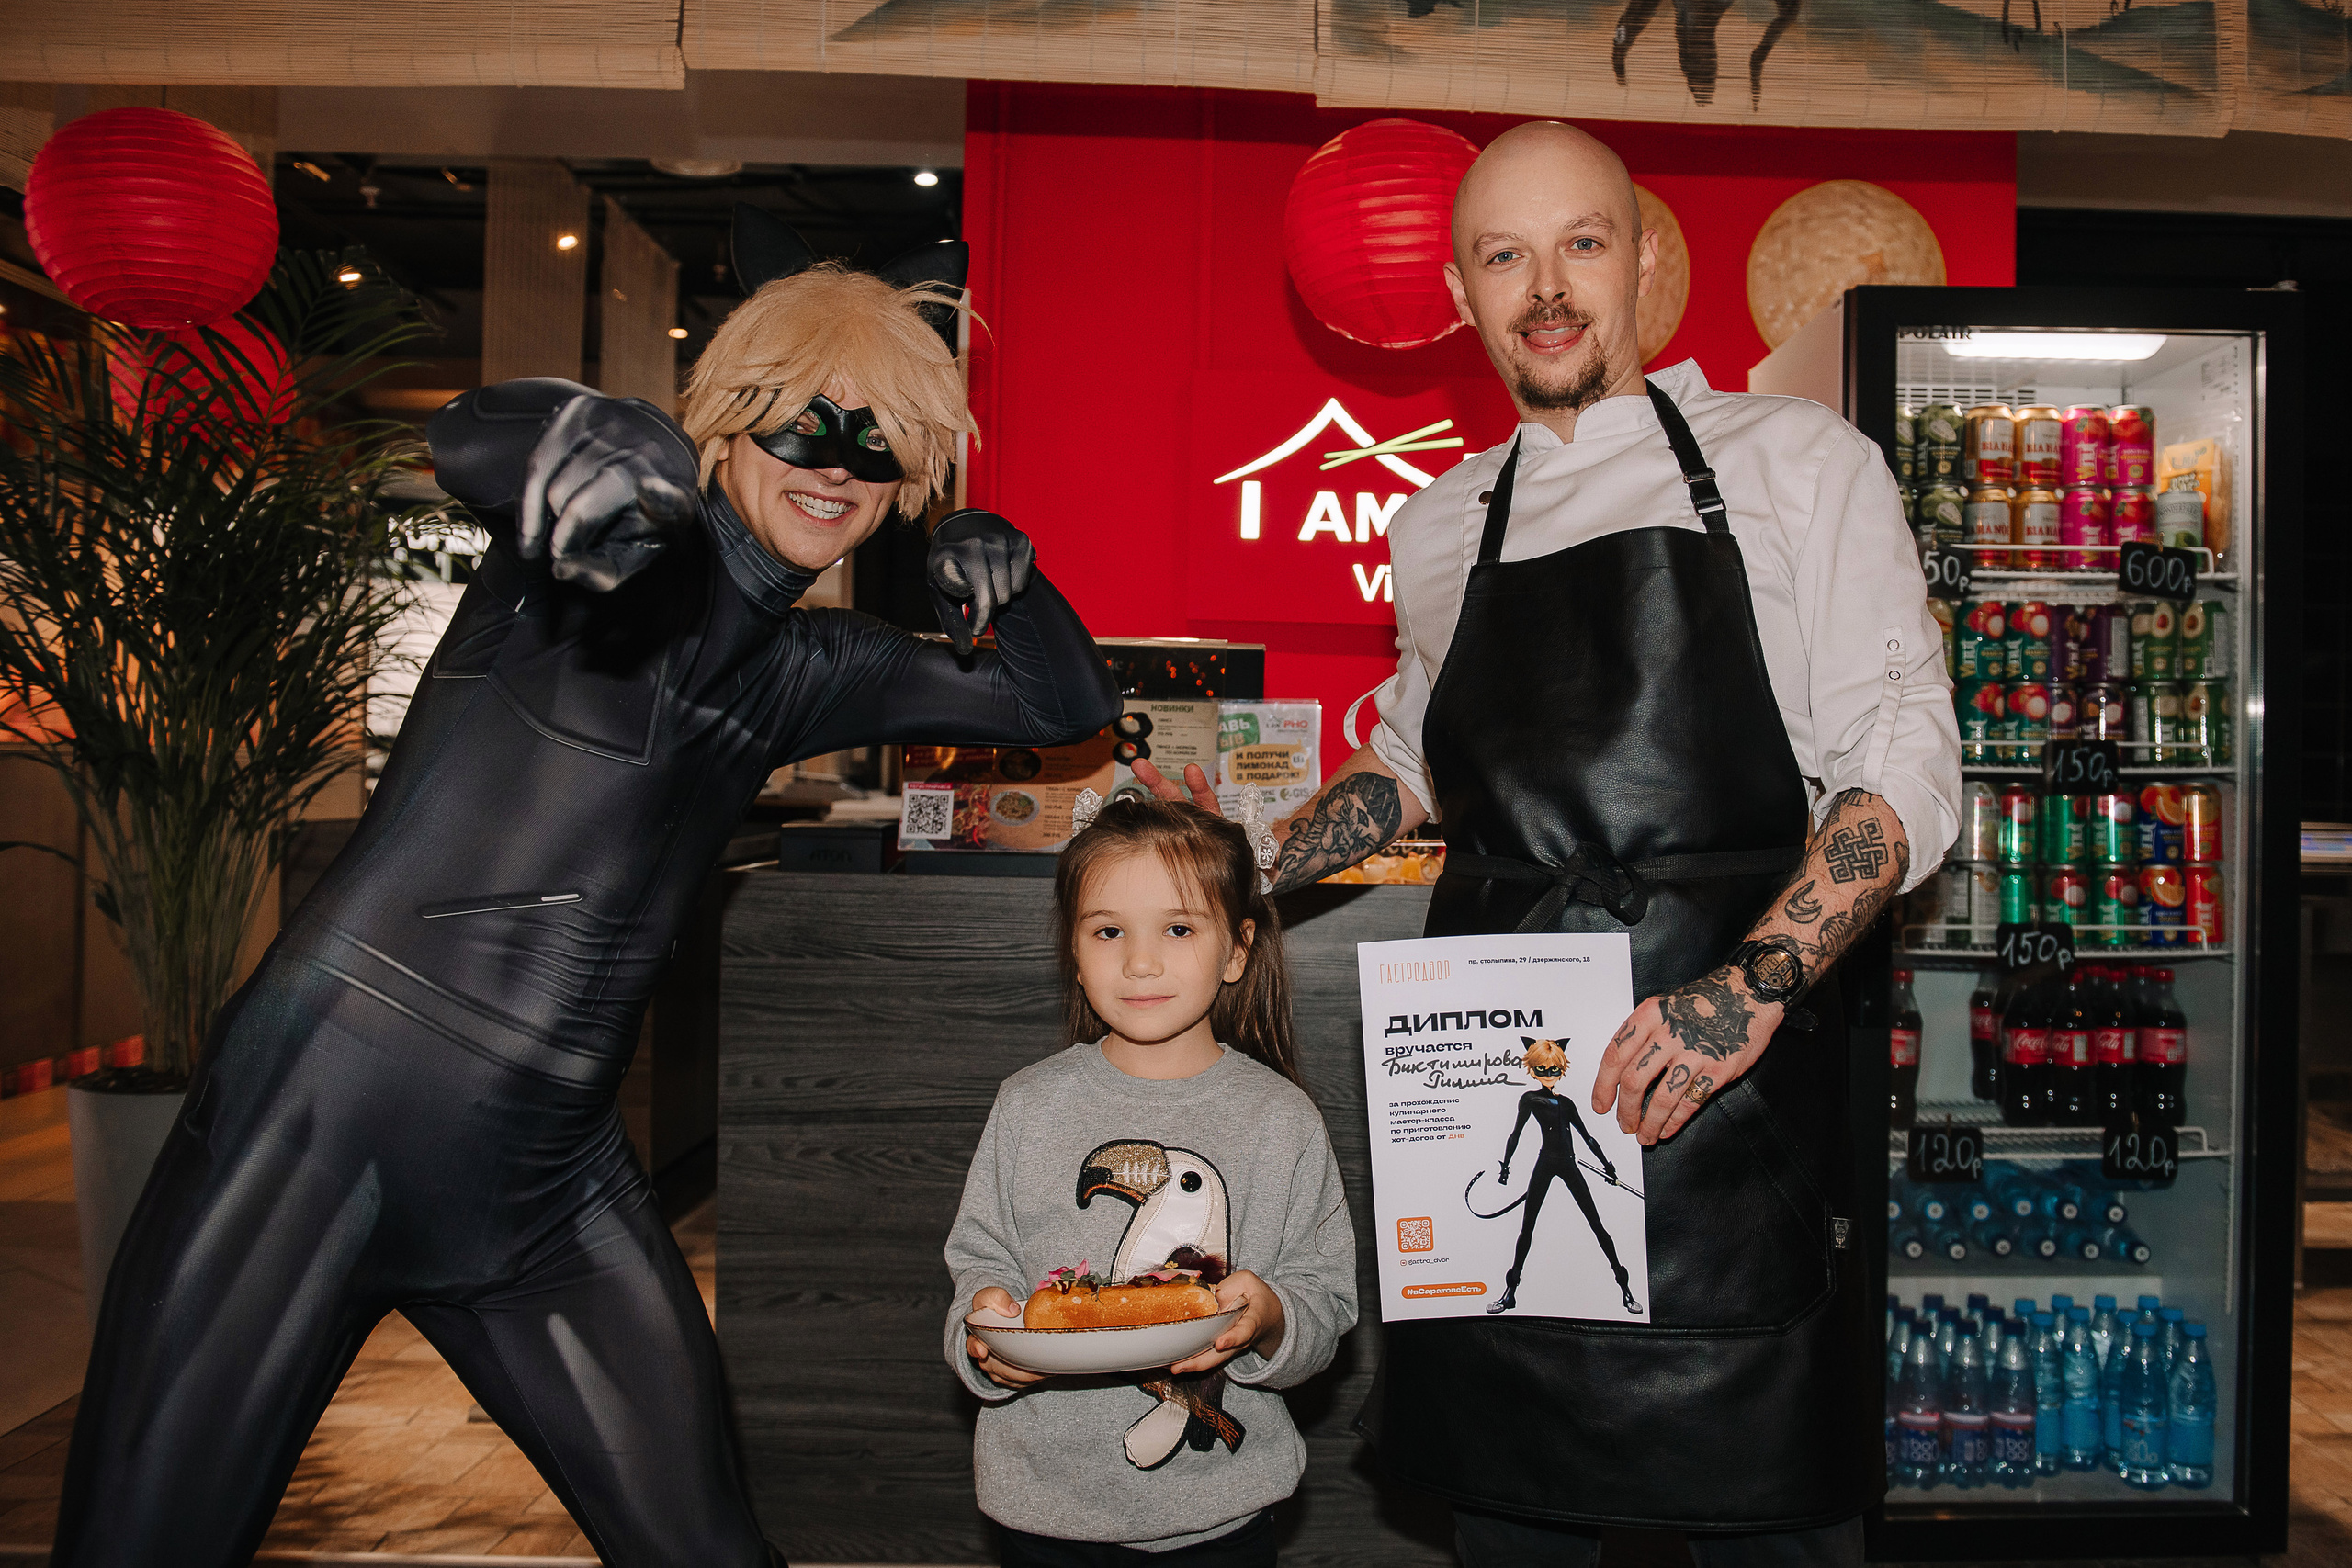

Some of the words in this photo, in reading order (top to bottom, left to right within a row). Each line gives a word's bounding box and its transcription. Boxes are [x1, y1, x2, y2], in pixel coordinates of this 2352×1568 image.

[1240, 480, 1261, 540] I
[1150, 704, 1194, 713] НОВИНКИ
[1246, 751, 1290, 760] ПОЛУЧИ
[1236, 761, 1290, 770] ЛИМОНАД
[1246, 772, 1300, 781] ПОДАРОК!
[1379, 959, 1451, 985] ГАСТРОДВОР
[1384, 1009, 1544, 1038] ДИПЛОМ
[1385, 1042, 1473, 1057] вручается
[1400, 1098, 1460, 1108] прохождение
[1389, 1108, 1446, 1117] кулинарного
[1390, 1116, 1455, 1125] мастер-класса
[1403, 1124, 1472, 1134] приготовлению
[1408, 1257, 1450, 1266] gastro_dvor
[1407, 1286, 1482, 1295] #вСаратовеЕсть
